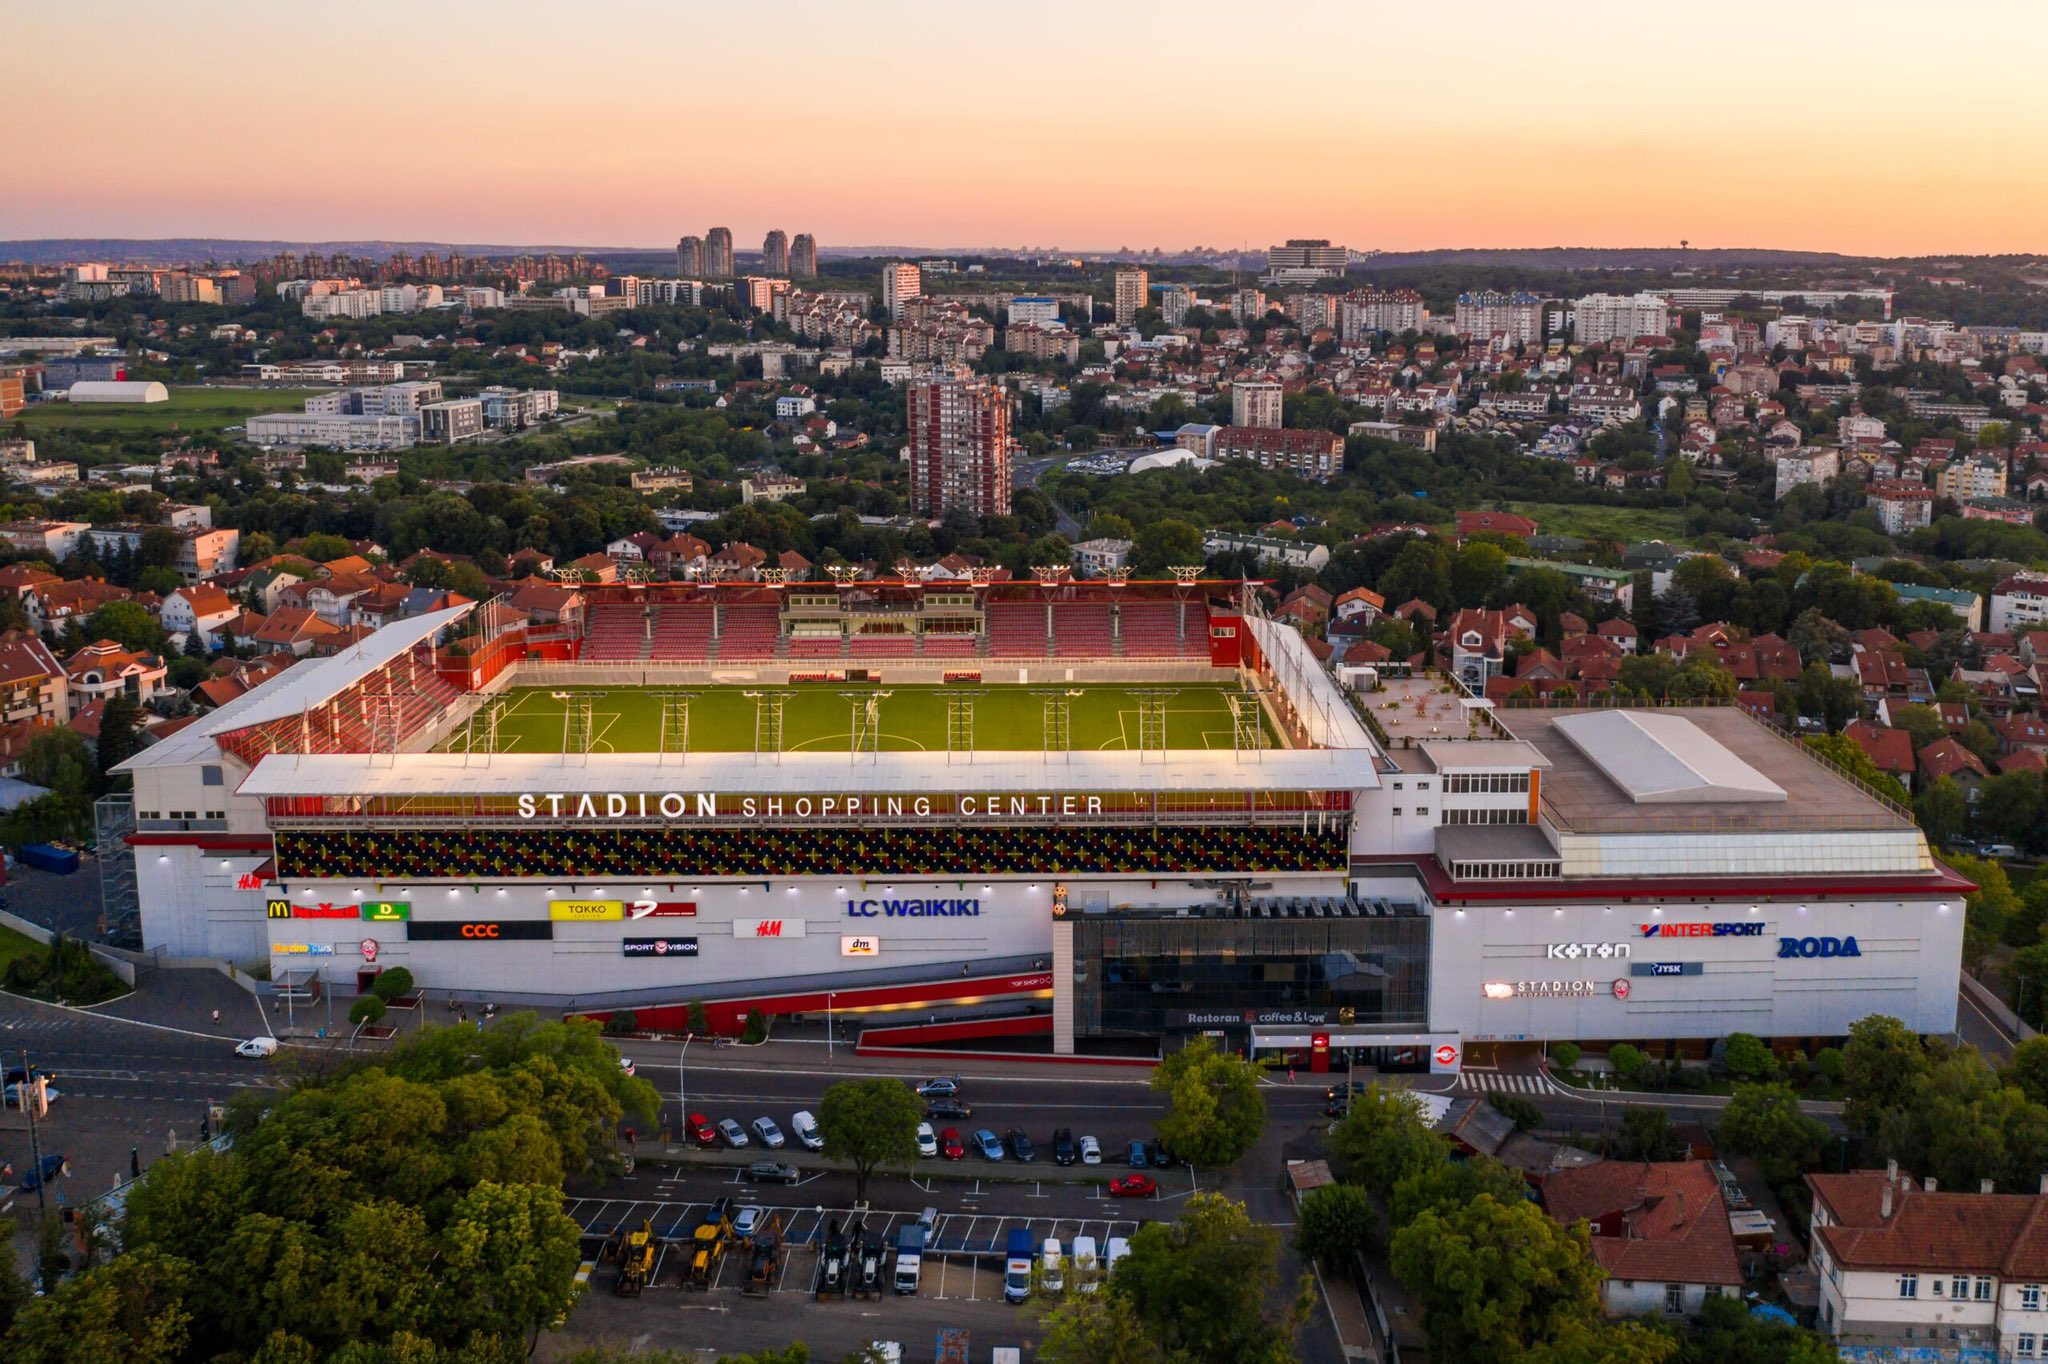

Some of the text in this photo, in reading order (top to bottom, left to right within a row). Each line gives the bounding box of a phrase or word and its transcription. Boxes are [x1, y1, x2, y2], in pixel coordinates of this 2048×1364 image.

[518, 793, 1101, 818] STADION SHOPPING CENTER
[238, 874, 263, 890] H&M
[848, 899, 879, 918] LC
[461, 924, 499, 938] CCC
[756, 920, 783, 937] H&M
[1660, 922, 1765, 938] INTERSPORT
[852, 939, 870, 949] dm
[1777, 936, 1861, 958] RODA
[1657, 964, 1681, 973] JYSK
[1518, 981, 1595, 992] STADION
[1188, 1013, 1240, 1023] Restoran
[1259, 1012, 1292, 1022] coffee
